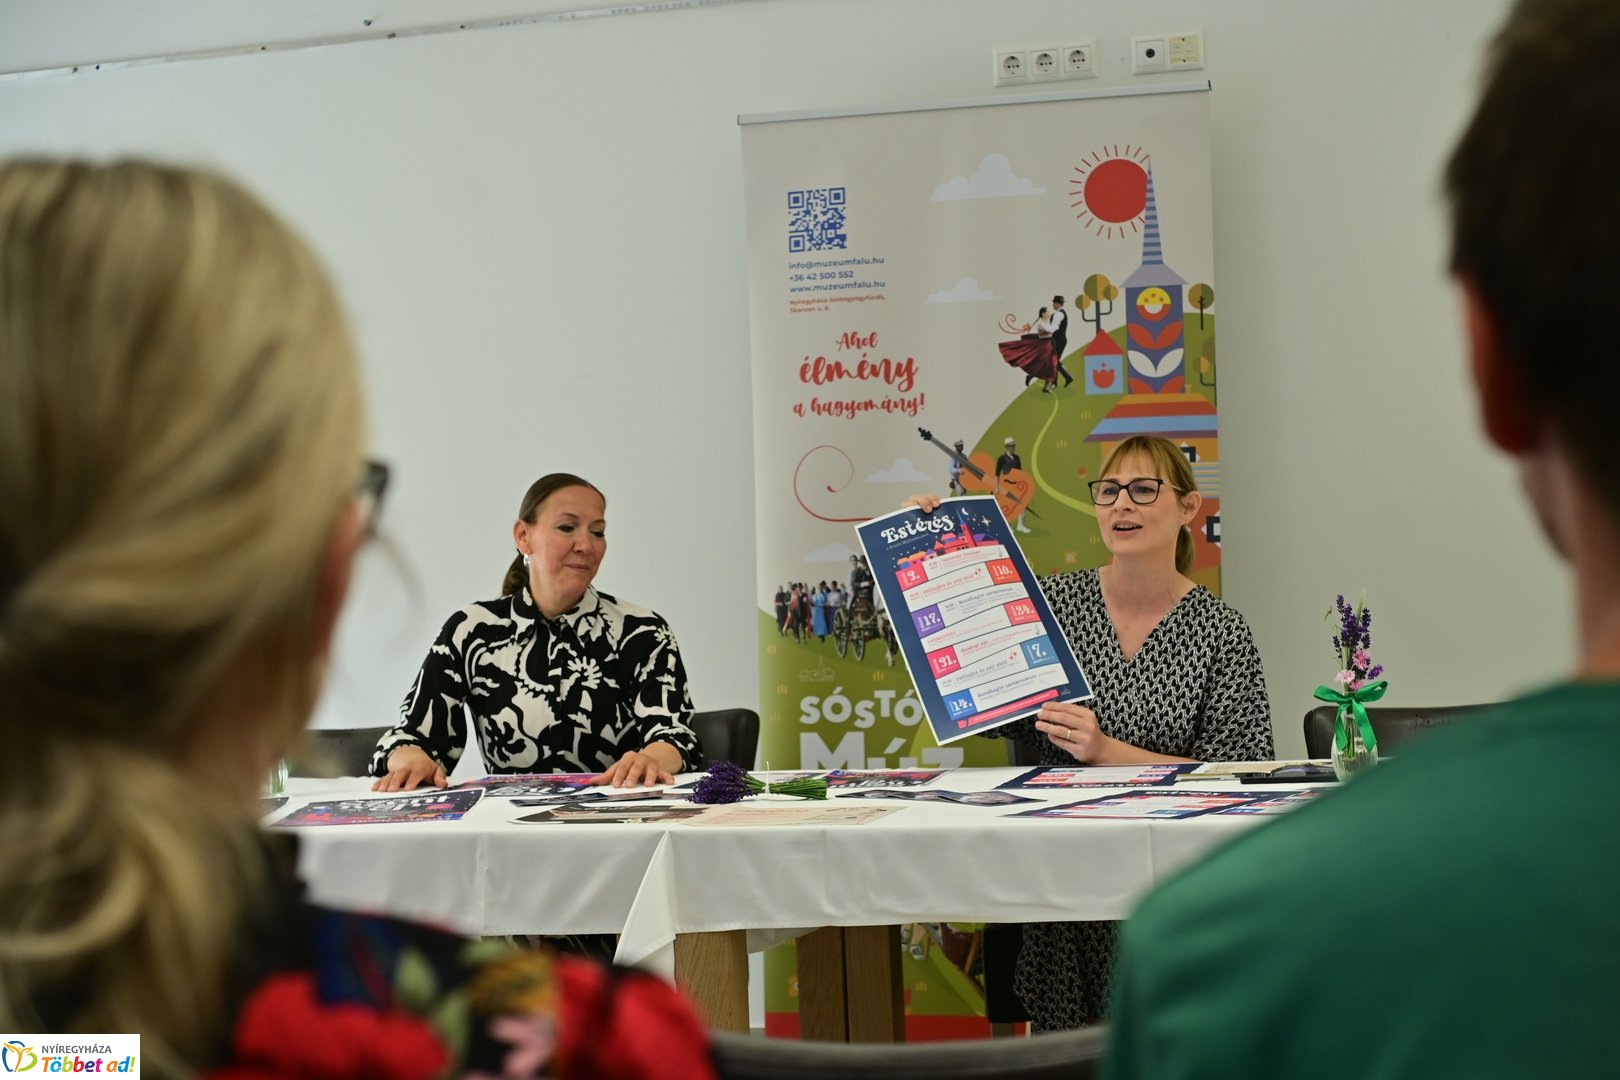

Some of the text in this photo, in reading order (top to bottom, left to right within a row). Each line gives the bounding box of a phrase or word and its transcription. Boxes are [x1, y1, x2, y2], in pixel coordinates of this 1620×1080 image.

[789, 257, 885, 271] info@muzeumfalu.hu
[789, 270, 854, 282] +36 42 500 552
[789, 280, 886, 293] www.muzeumfalu.hu
[836, 331, 878, 352] Ahol
[799, 352, 919, 393] élmény
[793, 392, 925, 420] a hagyomány!
[998, 565, 1013, 576] 10.
[923, 612, 941, 627] 17.
[1031, 643, 1047, 658] 7.
[938, 655, 957, 668] 31.
[952, 698, 973, 712] 14.
